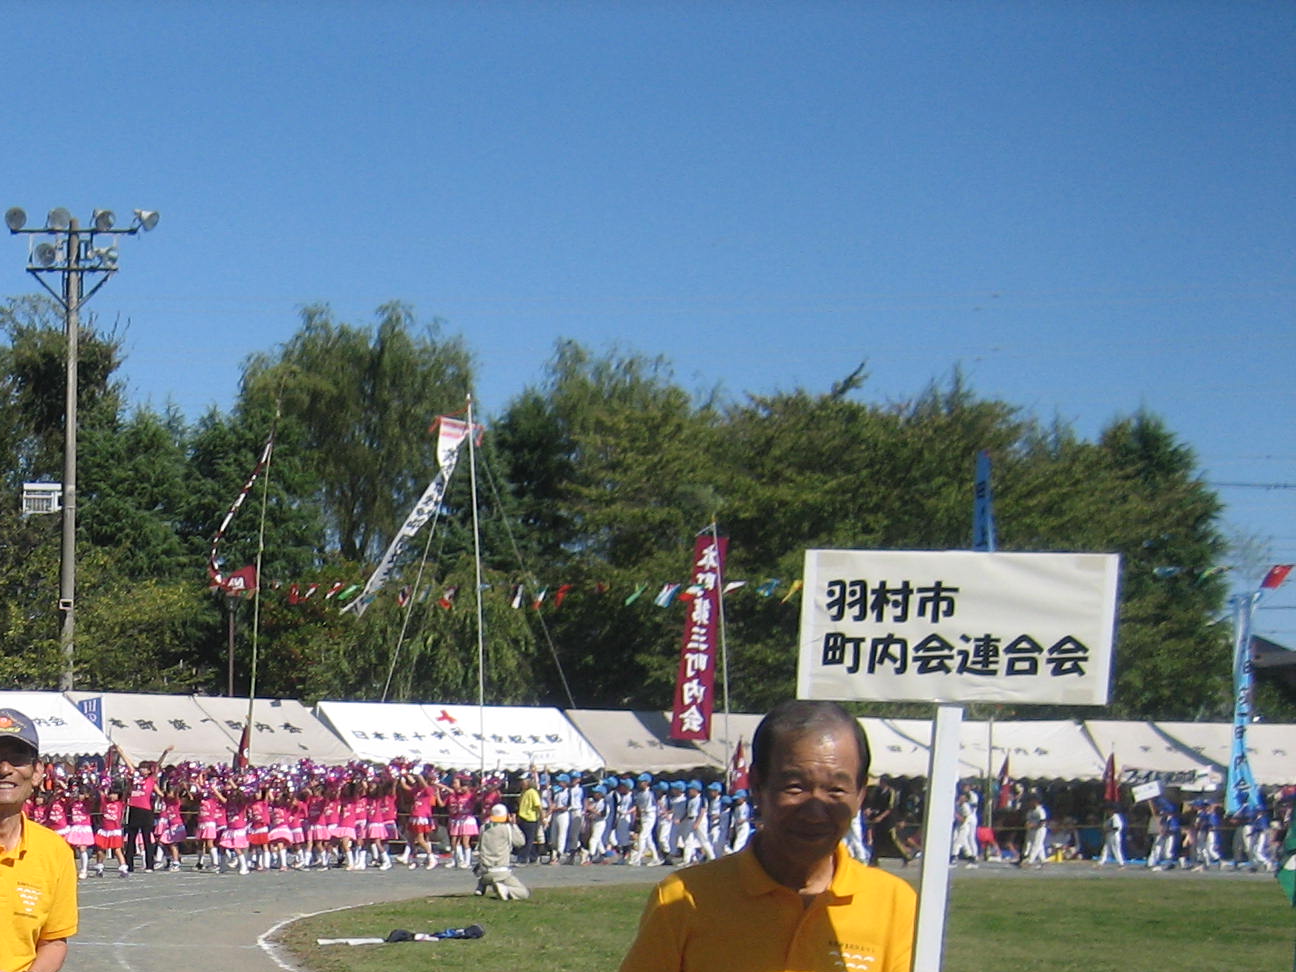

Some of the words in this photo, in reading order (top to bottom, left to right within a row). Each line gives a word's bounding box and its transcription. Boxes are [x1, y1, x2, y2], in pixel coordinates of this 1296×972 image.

[825, 579, 960, 624] 羽村市
[821, 632, 1090, 678] 町内会連合会
